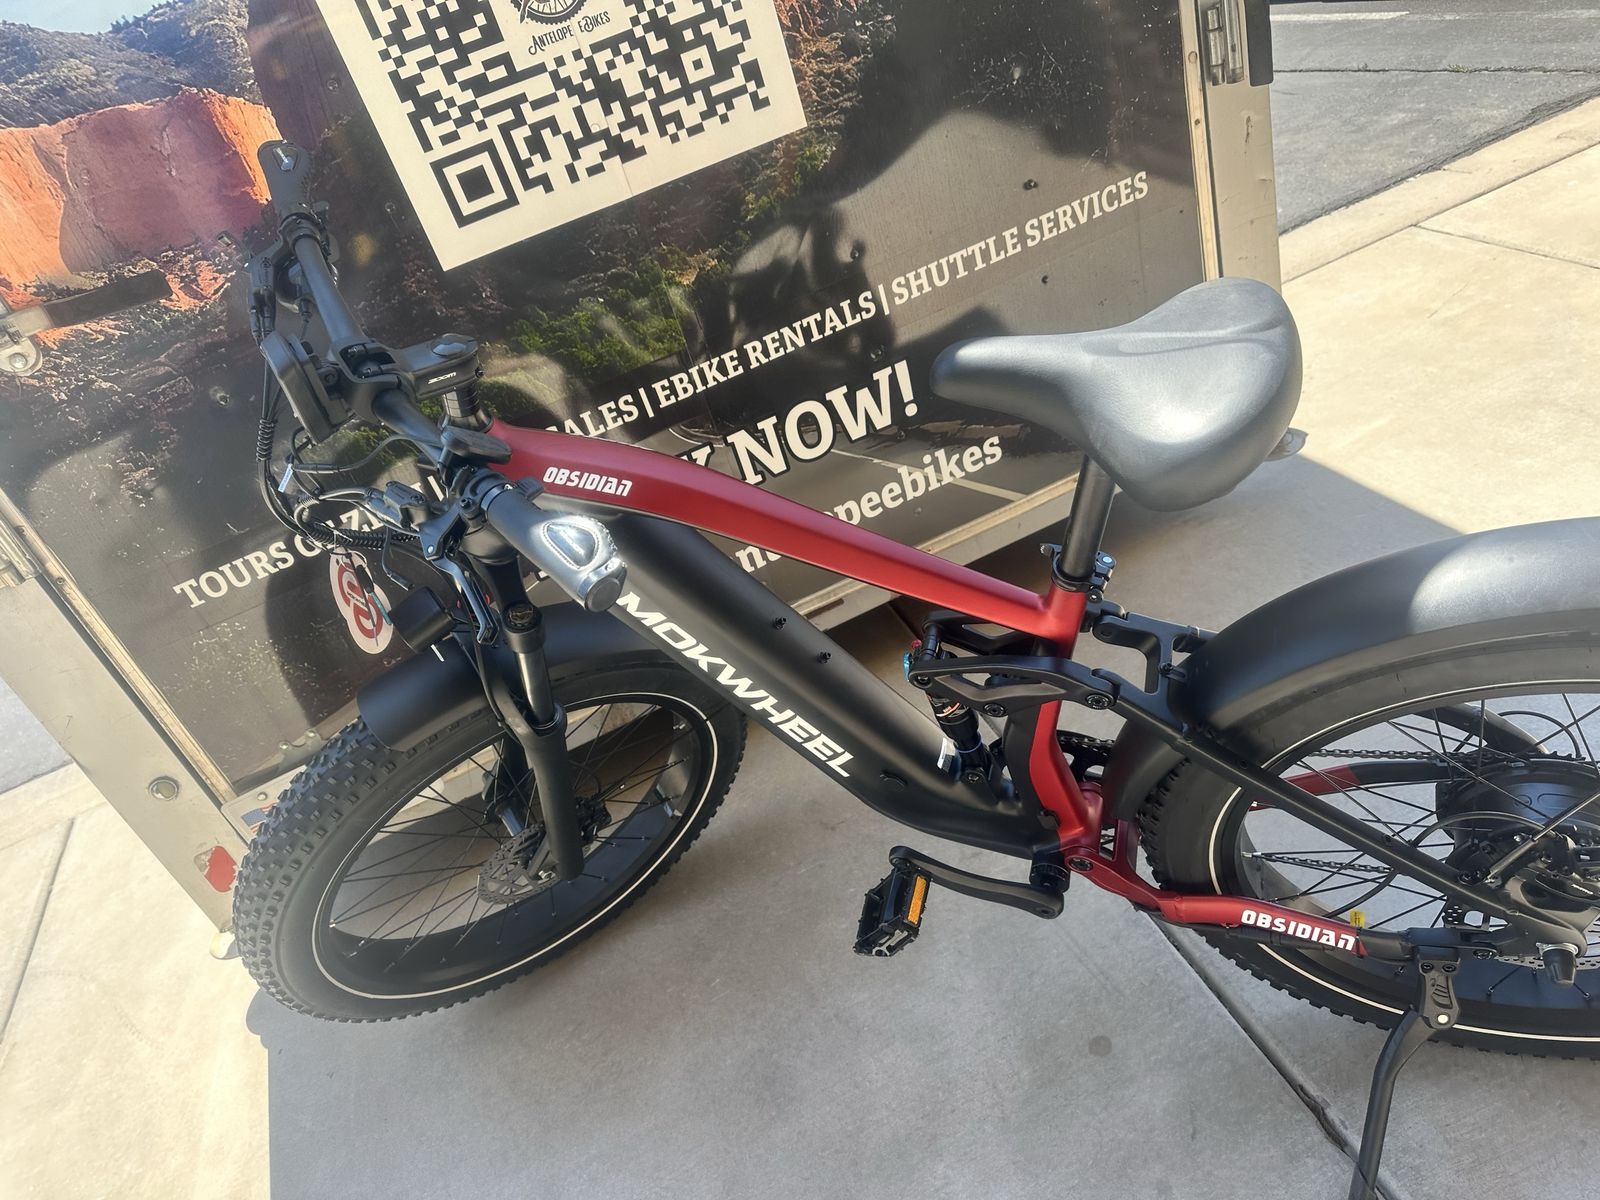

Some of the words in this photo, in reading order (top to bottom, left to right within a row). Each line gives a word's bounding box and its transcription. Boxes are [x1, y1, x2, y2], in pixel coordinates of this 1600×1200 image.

[528, 25, 574, 55] ANTELOPE
[172, 541, 295, 609] TOURS
[545, 394, 639, 437] ALES
[651, 349, 744, 408] EBIKE
[743, 290, 876, 369] RENTALS
[891, 227, 1022, 305] SHUTTLE
[1024, 171, 1149, 248] SERVICES
[727, 359, 918, 485] NOW!
[615, 591, 854, 777] MOKWHEEL
